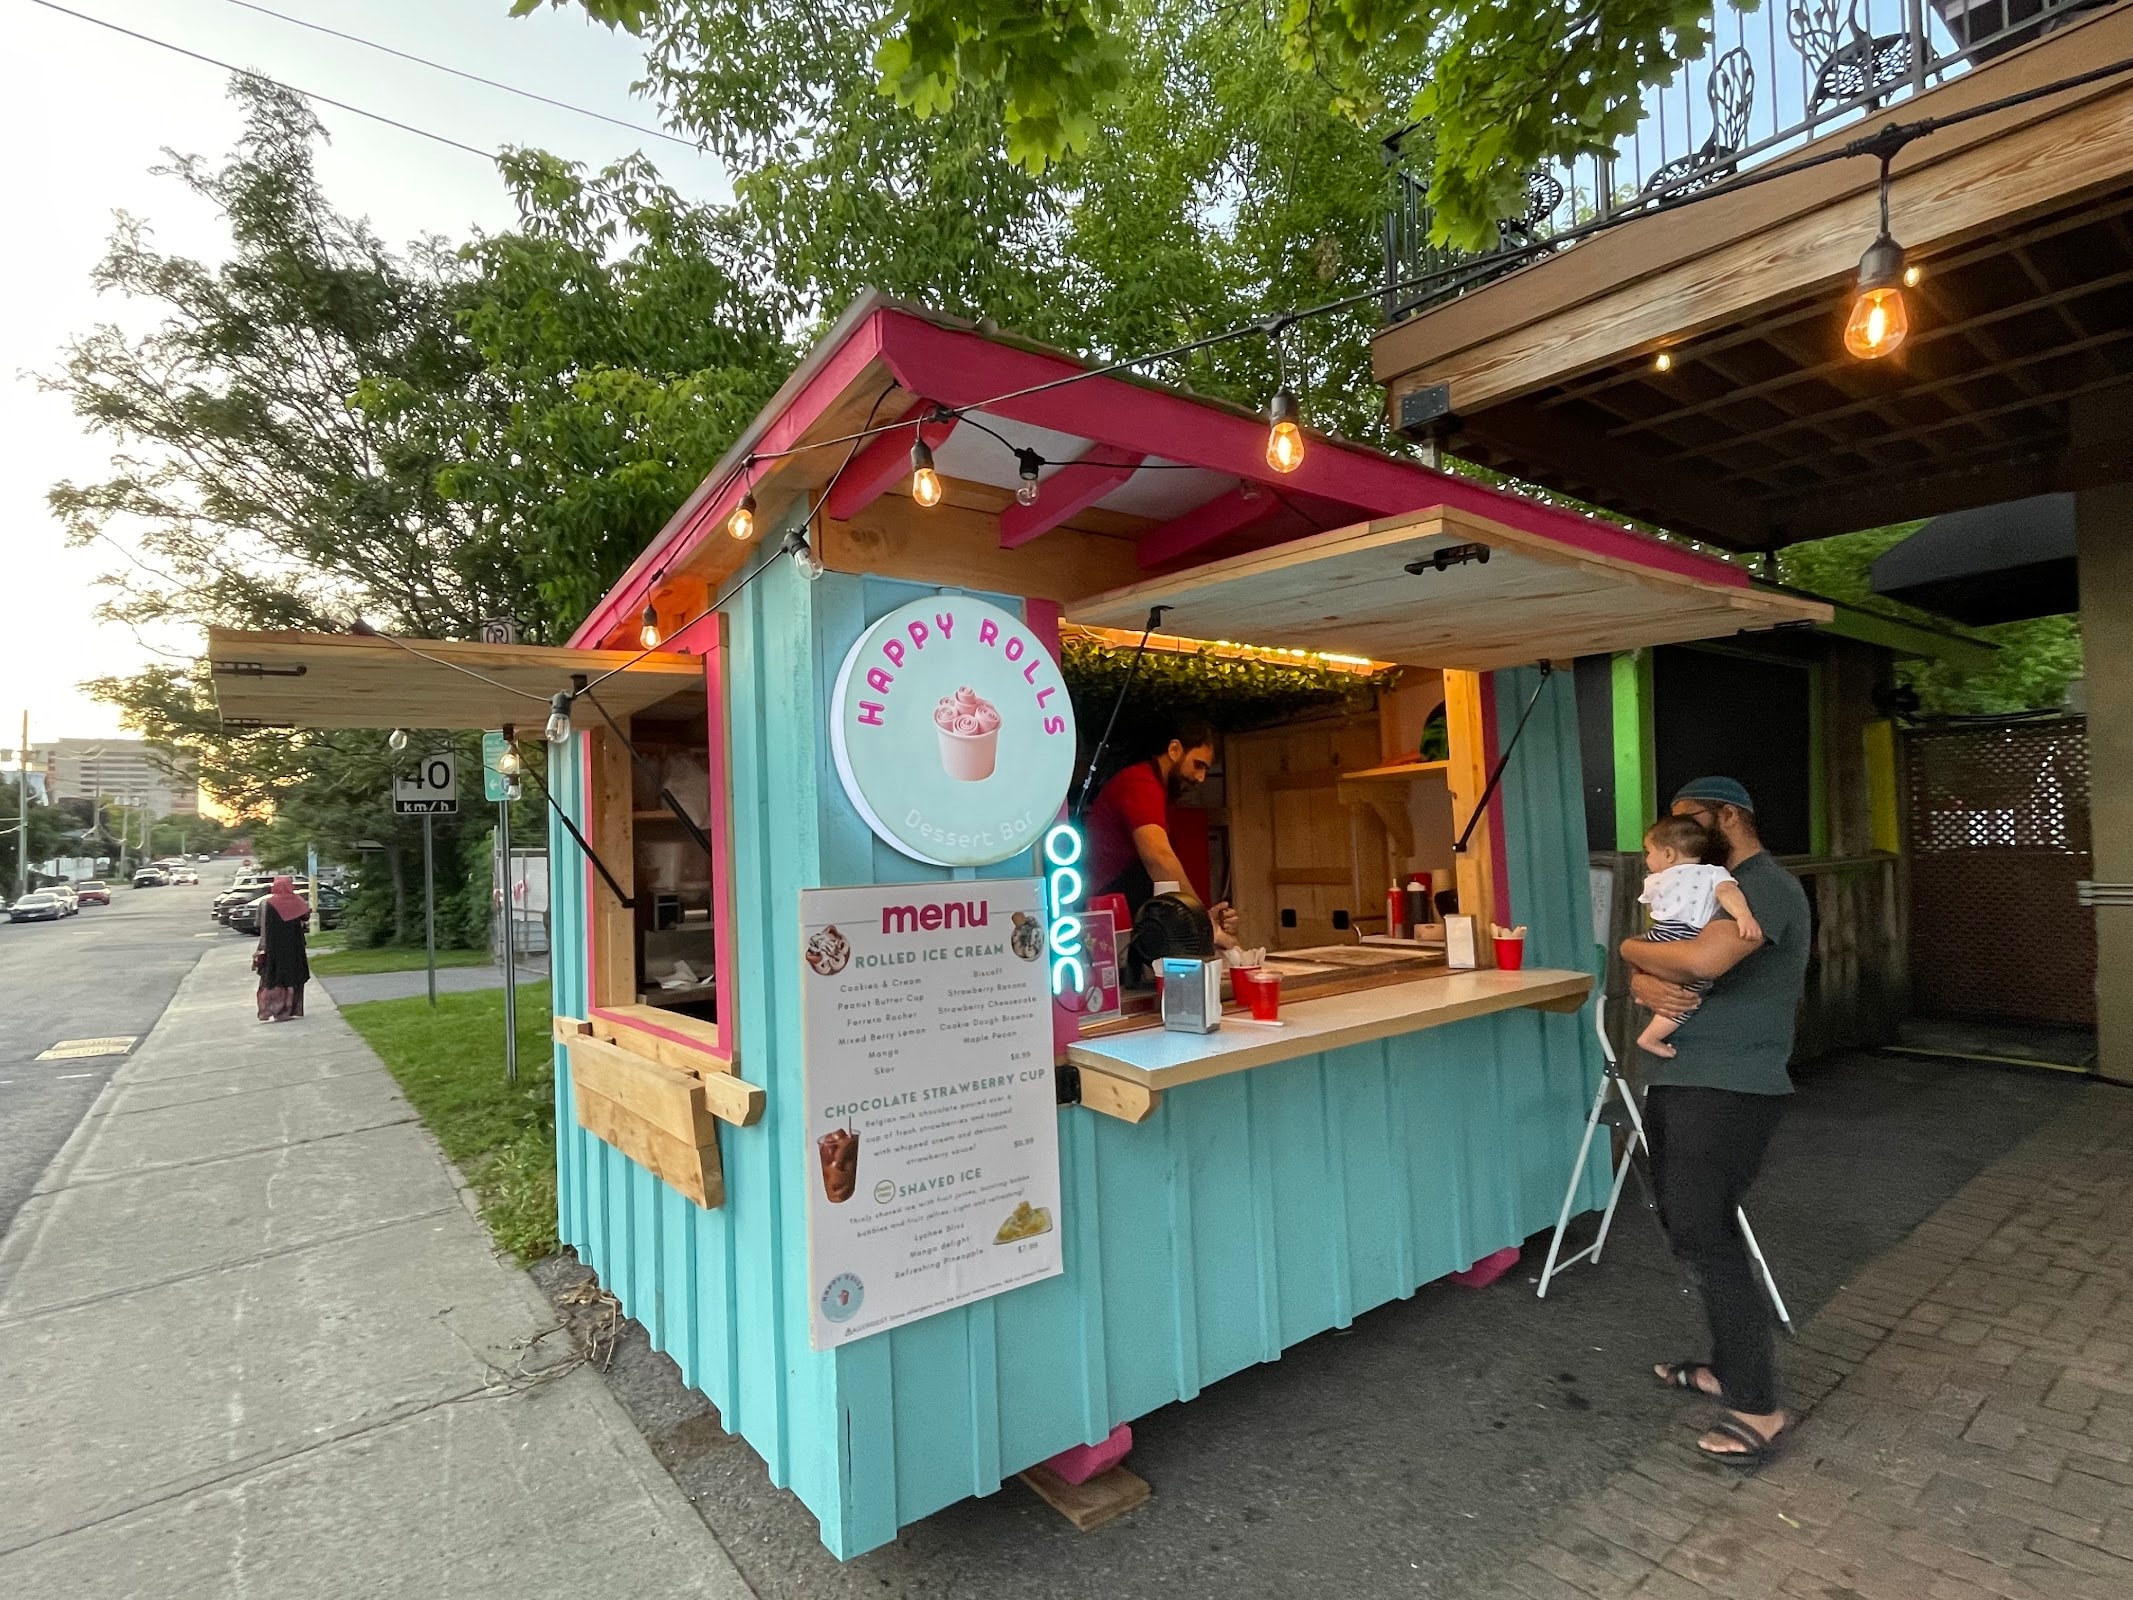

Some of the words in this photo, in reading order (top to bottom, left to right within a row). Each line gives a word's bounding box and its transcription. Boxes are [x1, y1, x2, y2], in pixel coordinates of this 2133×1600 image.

[858, 612, 954, 726] HAPPY
[979, 618, 1065, 735] ROLLS
[404, 801, 449, 812] km/h
[904, 808, 994, 848] Dessert
[1000, 810, 1033, 841] Bar
[882, 901, 987, 934] menu
[1045, 824, 1084, 996] open
[856, 953, 916, 969] ROLLED
[923, 950, 947, 962] ICE
[955, 944, 1004, 958] CREAM
[840, 982, 878, 993] Cookies
[893, 978, 921, 987] Cream
[948, 986, 993, 997] Strawberry
[997, 982, 1026, 991] Banana
[838, 1001, 870, 1010] Peanut
[875, 998, 903, 1006] Butter
[907, 994, 924, 1002] Cup
[938, 1003, 984, 1014] Strawberry
[988, 997, 1036, 1008] Cheesecake
[847, 1017, 881, 1027] Ferrero
[886, 1012, 916, 1022] Rocher
[940, 1022, 969, 1030] Cookie
[973, 1018, 998, 1027] Dough
[1003, 1012, 1033, 1021] Brownie
[838, 1036, 866, 1045] Mixed
[870, 1032, 894, 1041] Berry
[899, 1028, 926, 1037] Lemon
[964, 1034, 989, 1044] Maple
[992, 1030, 1016, 1038] Pecan
[869, 1049, 899, 1058] Mango
[825, 1092, 917, 1118] CHOCOLATE
[923, 1074, 1015, 1100] STRAWBERRY
[1020, 1069, 1046, 1082] CUP
[899, 1175, 954, 1197] SHAVED
[961, 1168, 982, 1183] ICE
[914, 1229, 942, 1241] Lychee
[910, 1248, 938, 1258] Mango
[895, 1261, 940, 1279] Refreshing
